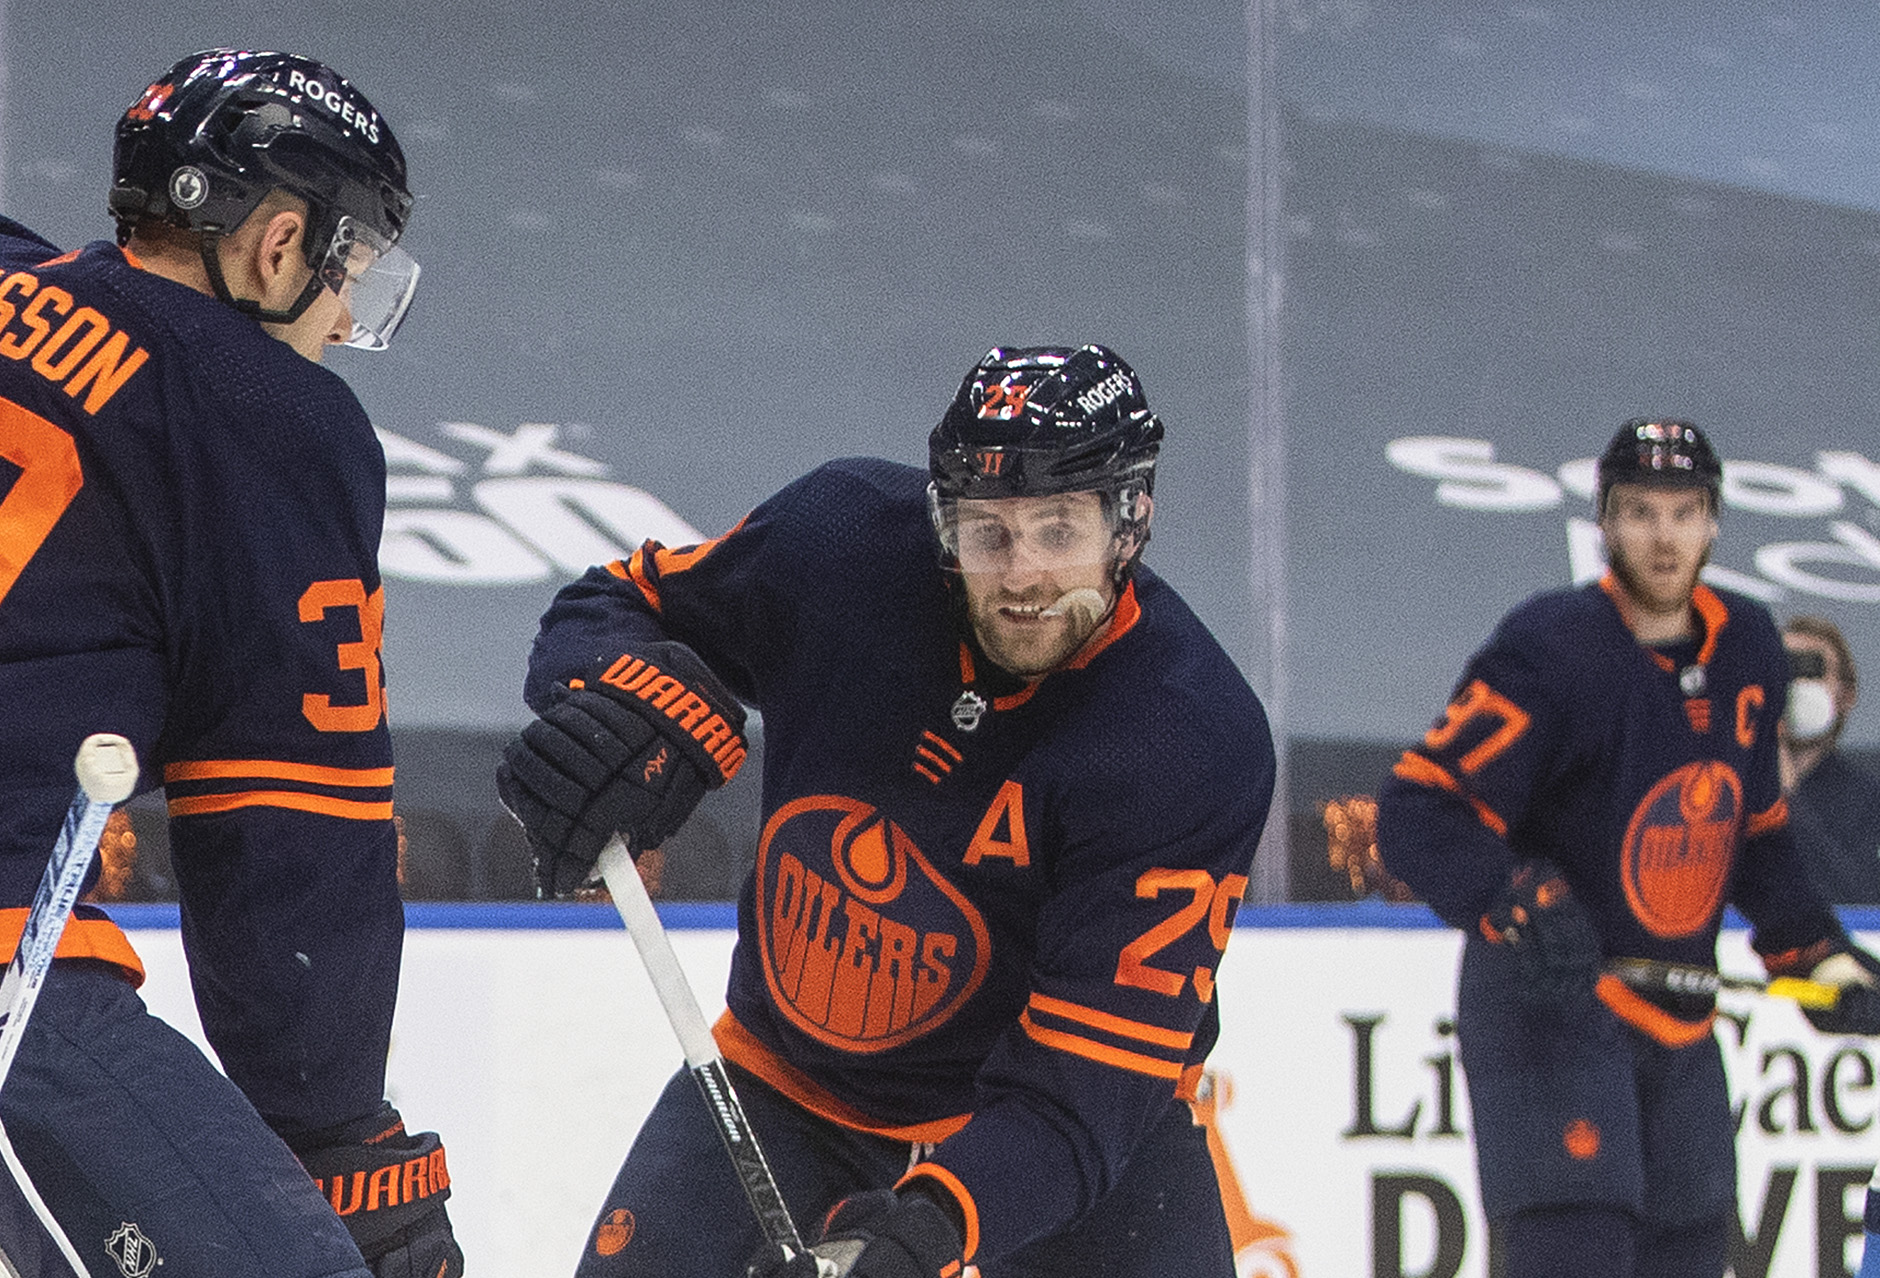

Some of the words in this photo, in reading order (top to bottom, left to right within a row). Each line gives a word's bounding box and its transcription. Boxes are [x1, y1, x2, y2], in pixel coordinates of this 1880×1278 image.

[288, 69, 380, 145] ROGERS
[1076, 369, 1134, 415] ROGERS
[298, 577, 389, 732] 3
[1735, 685, 1765, 747] C
[962, 779, 1031, 867] A
[773, 852, 957, 1040] OILERS
